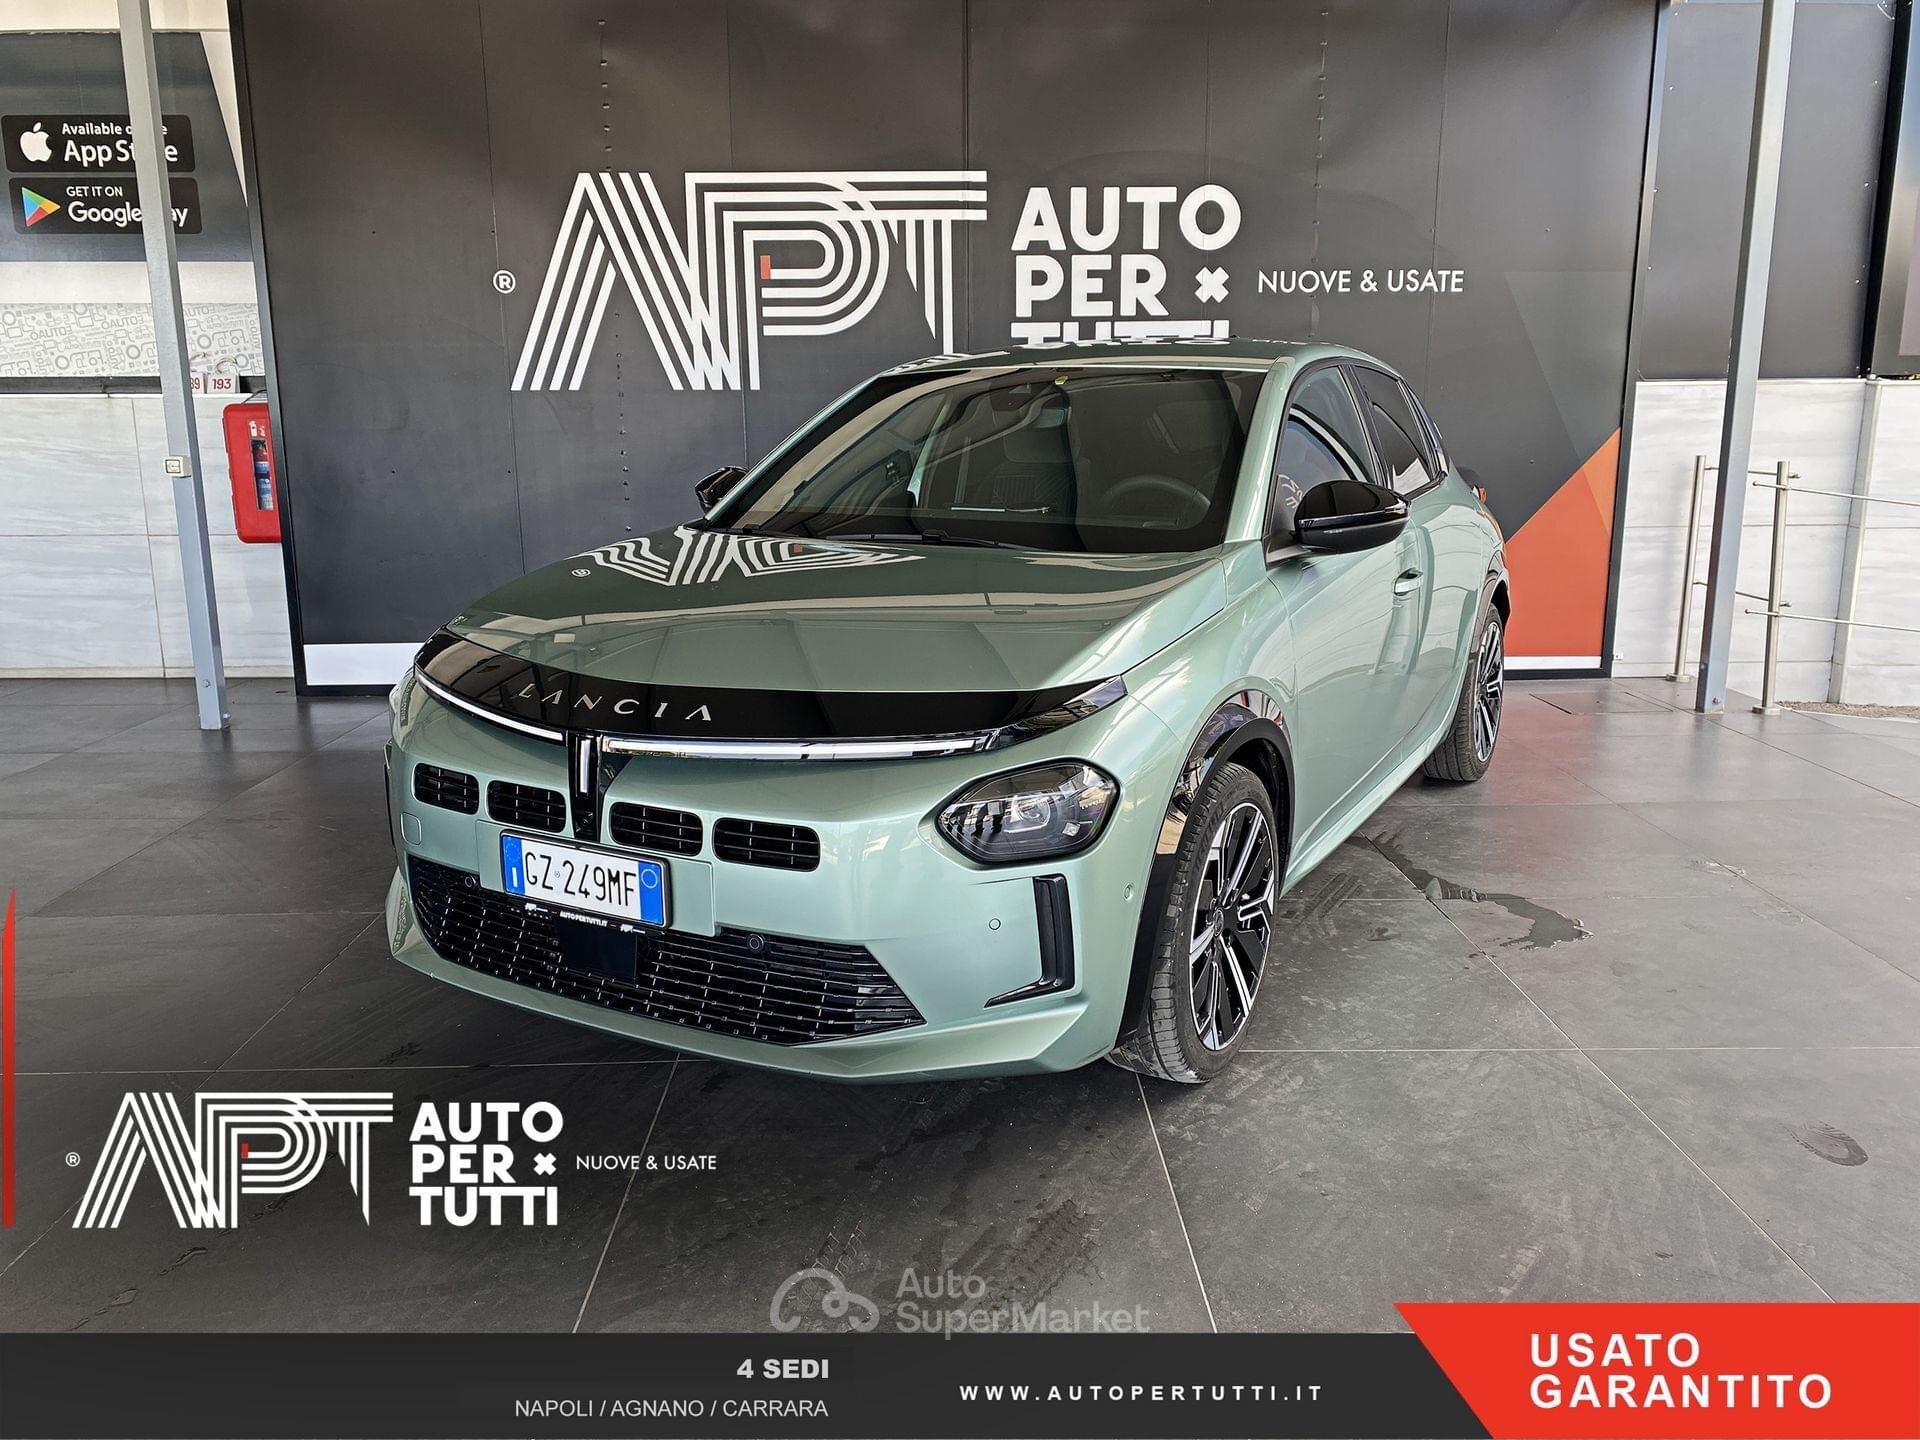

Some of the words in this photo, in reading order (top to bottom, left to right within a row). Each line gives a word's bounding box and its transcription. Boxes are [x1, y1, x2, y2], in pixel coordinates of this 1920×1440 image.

[61, 122, 123, 135] Available
[64, 139, 113, 167] App
[115, 139, 178, 162] Ste
[66, 186, 89, 197] GET
[92, 186, 102, 197] IT
[104, 186, 123, 197] ON
[67, 201, 142, 228] Google
[1011, 184, 1241, 252] AUTO
[1015, 254, 1169, 318] PER
[1259, 270, 1352, 294] NUOVE
[1360, 269, 1379, 293] &
[1387, 268, 1465, 294] USATE
[212, 378, 232, 390] 193
[518, 683, 712, 721] LANCIA
[525, 852, 554, 890] GZ
[562, 860, 637, 907] 249MF
